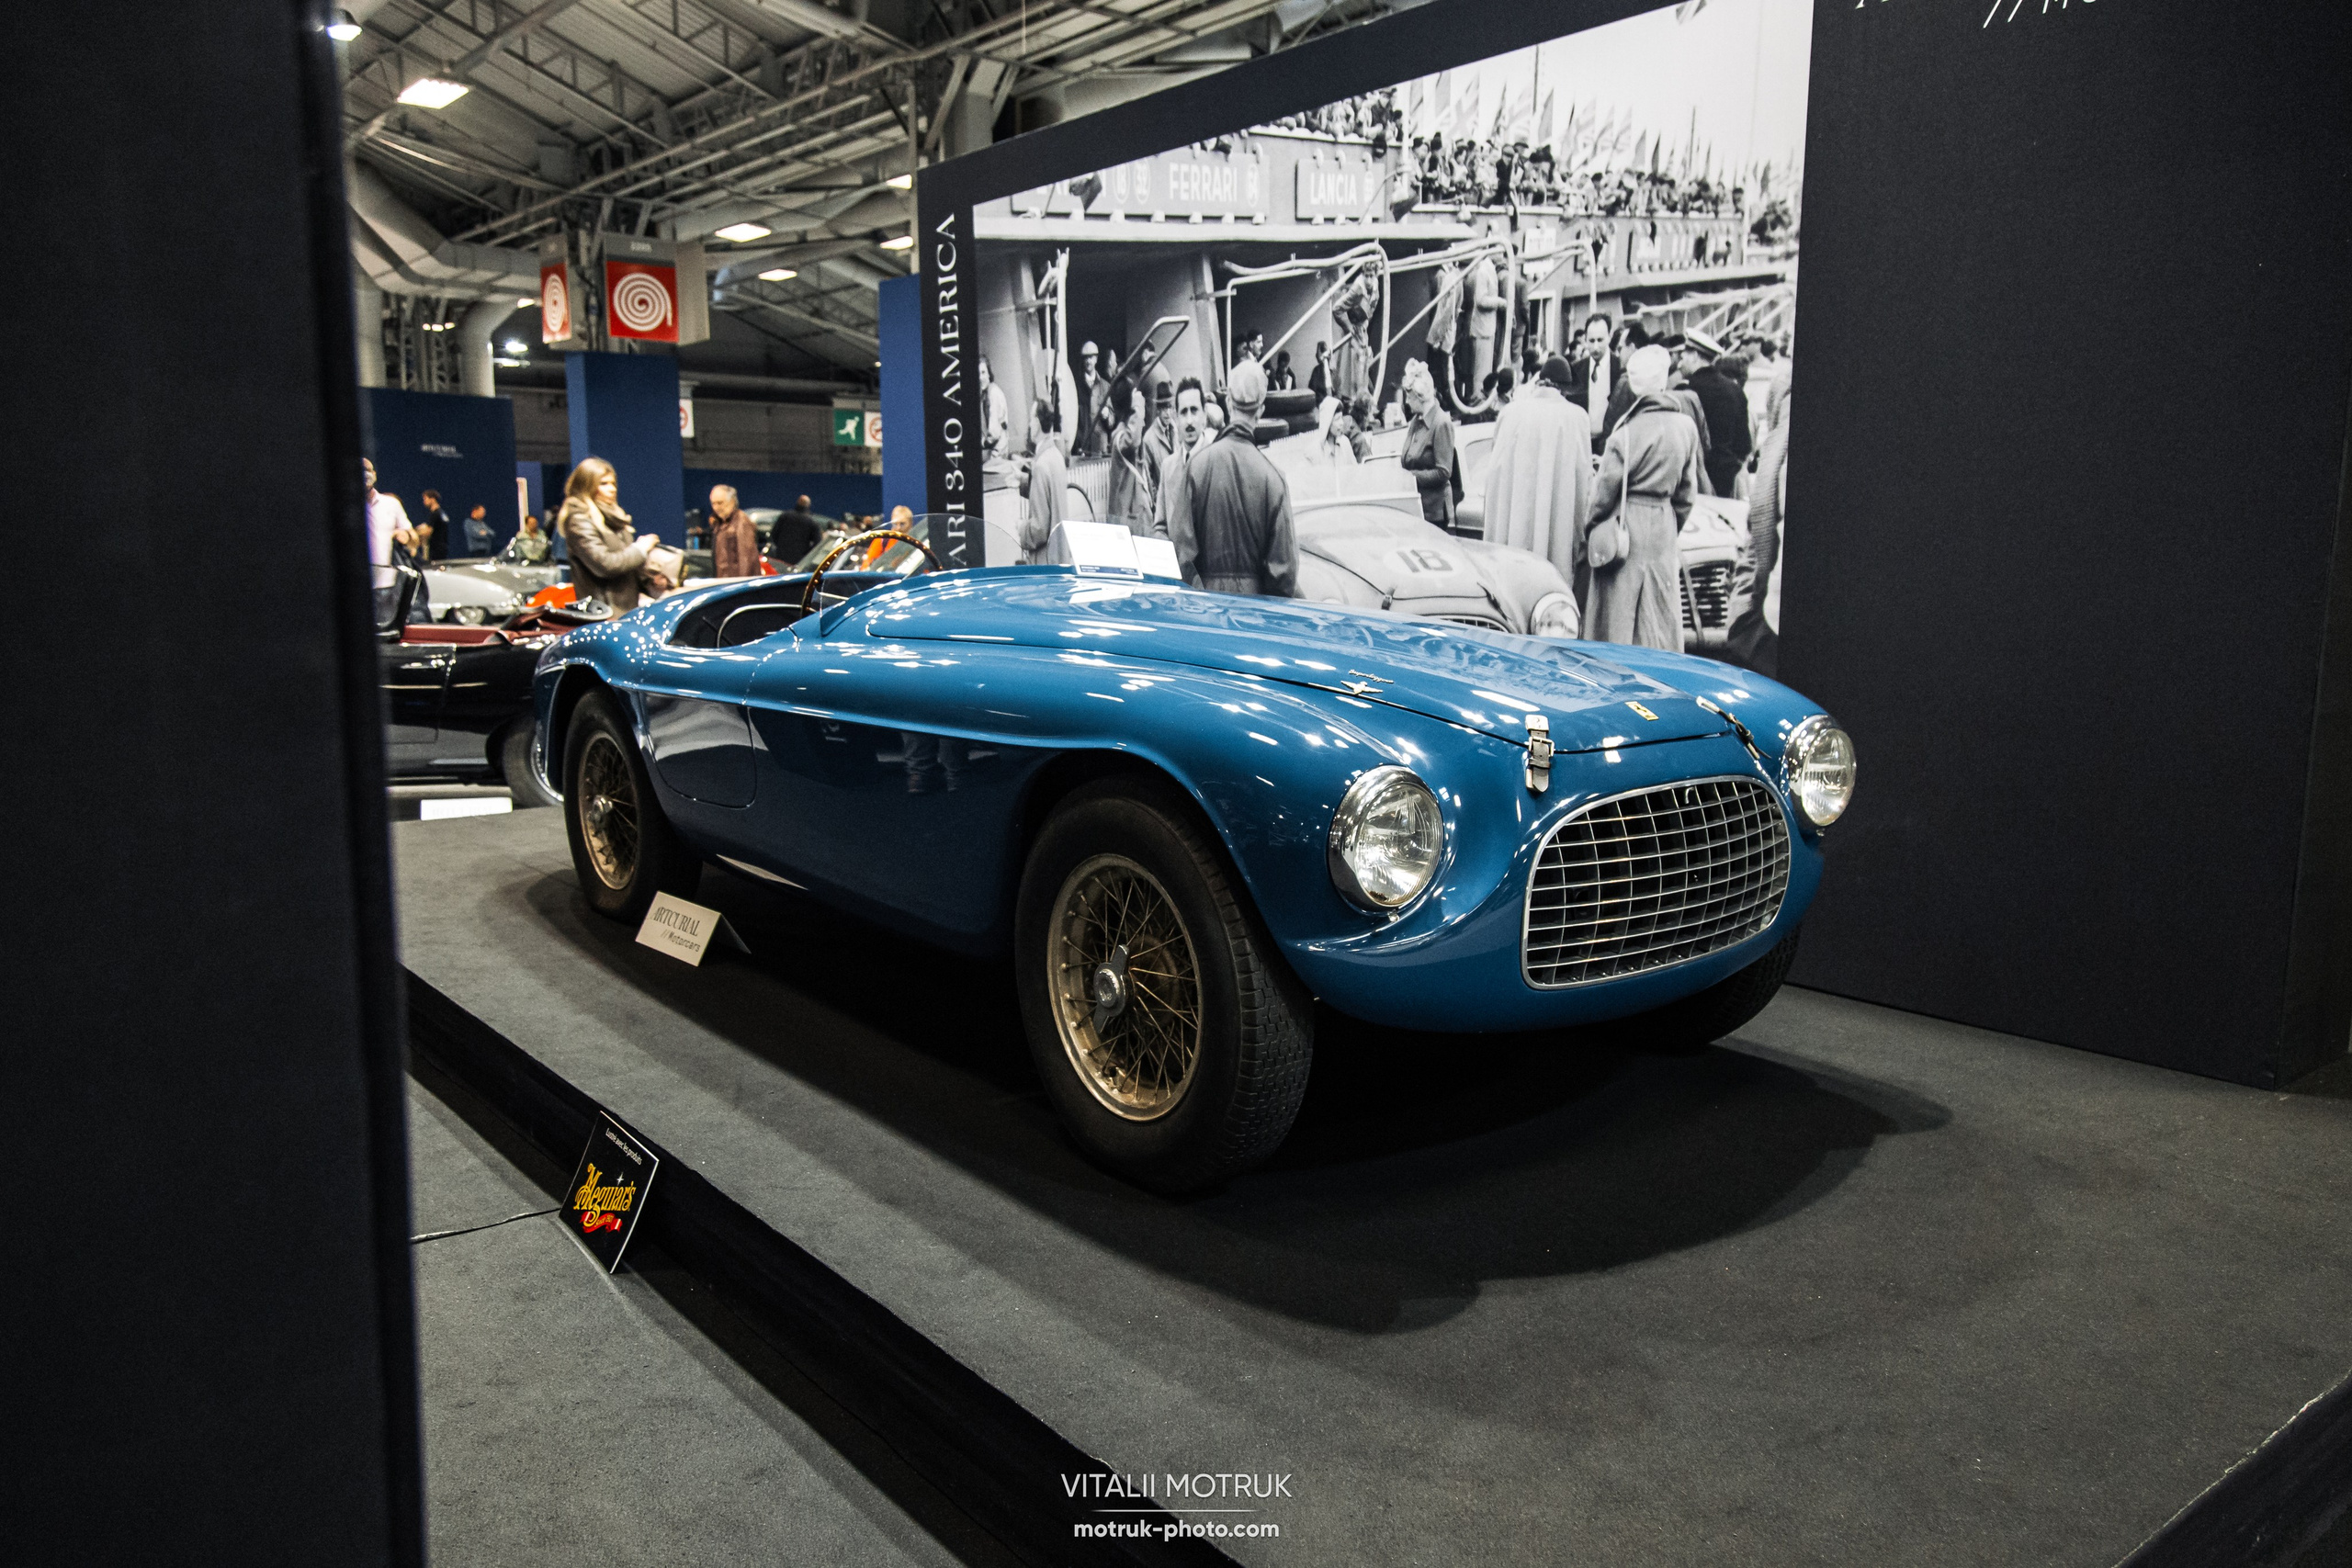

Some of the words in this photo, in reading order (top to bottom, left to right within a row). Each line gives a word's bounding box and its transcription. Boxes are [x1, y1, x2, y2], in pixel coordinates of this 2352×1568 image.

[1168, 162, 1238, 202] FERRARI
[1310, 172, 1358, 205] LANCIA
[935, 212, 962, 406] AMERICA
[944, 418, 965, 491] 340
[1396, 549, 1453, 573] 18
[650, 906, 700, 937] ARTCURIAL
[573, 1163, 637, 1227] Meguiar's
